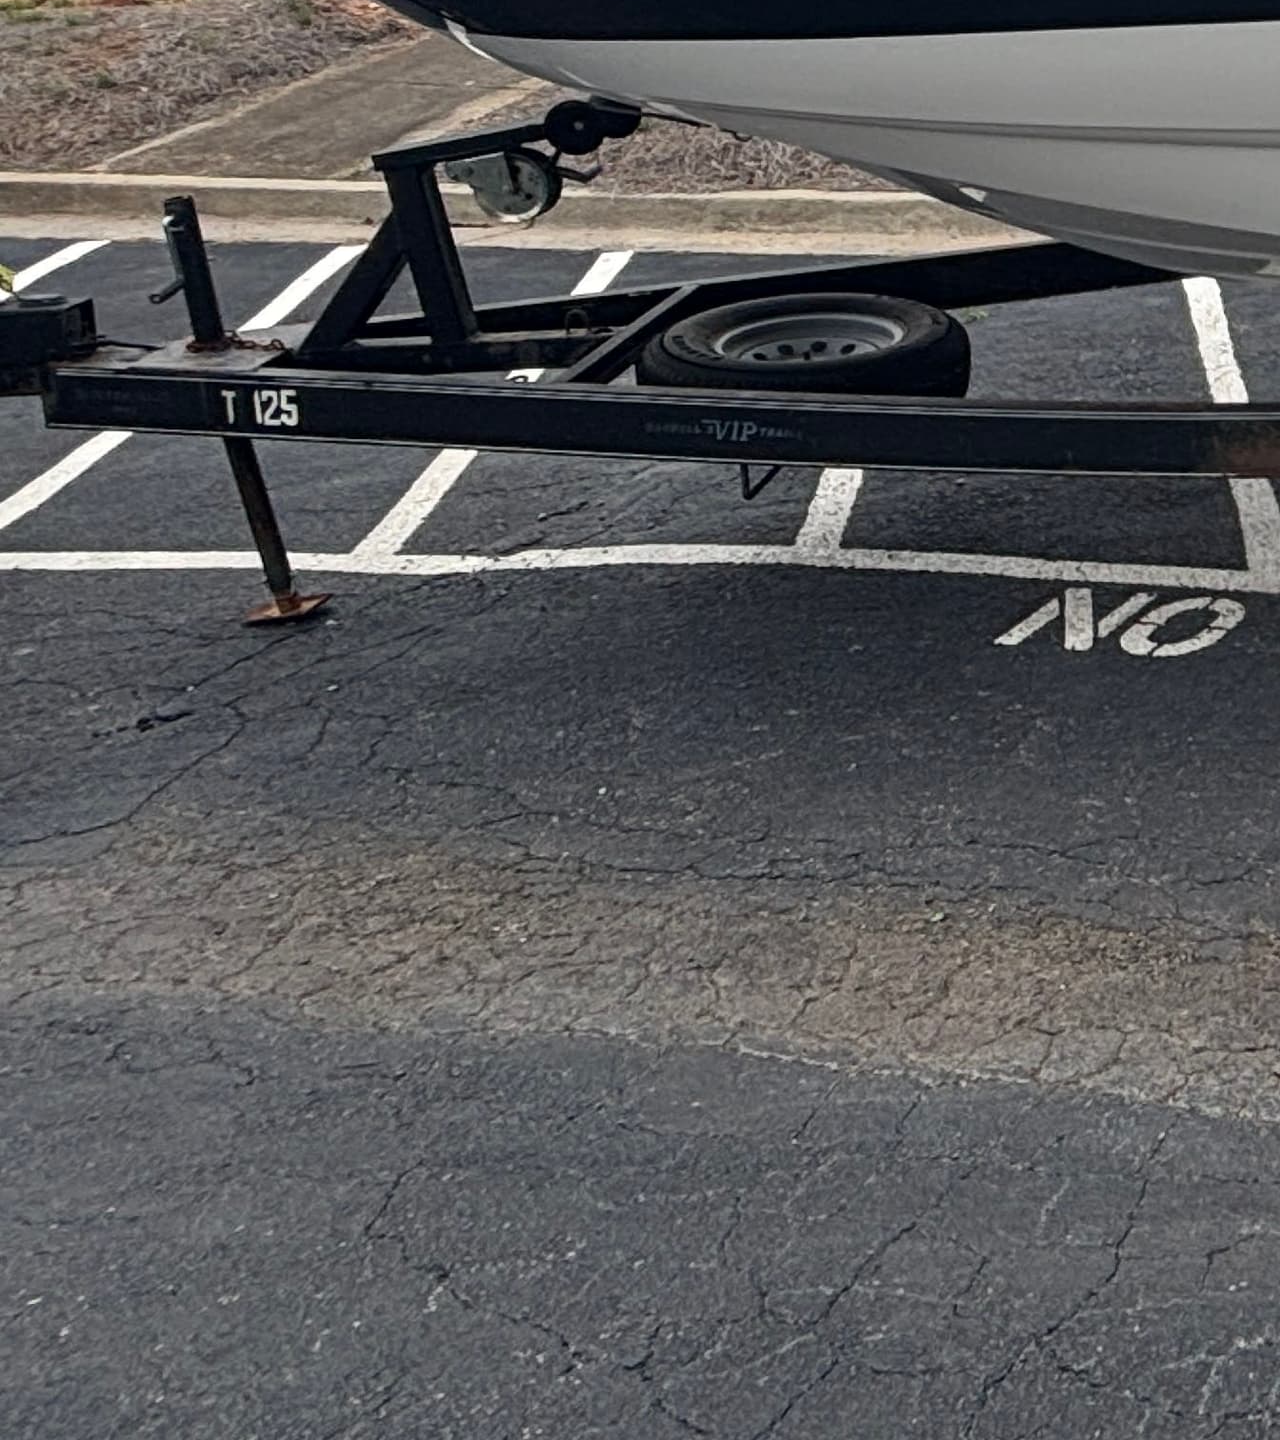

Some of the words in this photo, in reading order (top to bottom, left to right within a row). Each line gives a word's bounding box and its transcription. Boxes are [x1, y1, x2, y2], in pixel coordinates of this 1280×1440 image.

[221, 389, 236, 425] T
[253, 389, 299, 427] 125
[706, 418, 758, 441] VIP
[995, 586, 1246, 658] NO
